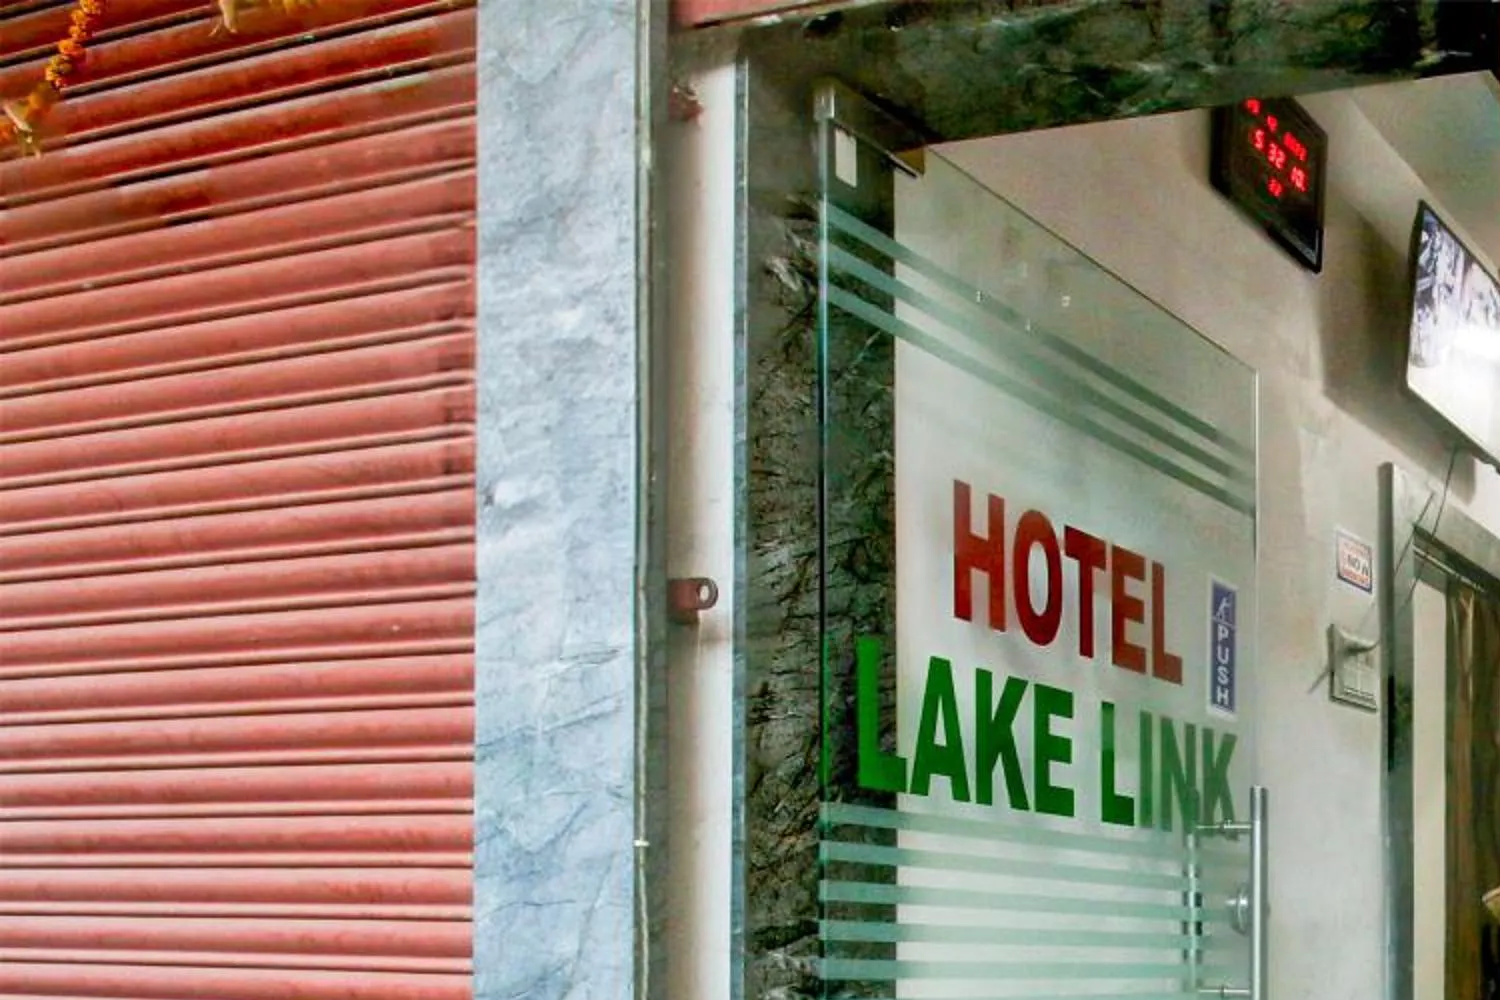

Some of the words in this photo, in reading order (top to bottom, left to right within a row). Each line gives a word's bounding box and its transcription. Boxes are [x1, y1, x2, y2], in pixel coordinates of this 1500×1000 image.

[953, 478, 1183, 686] HOTEL
[1215, 622, 1230, 707] PUSH
[856, 635, 1075, 818] LAKE
[1101, 700, 1239, 840] LINK
